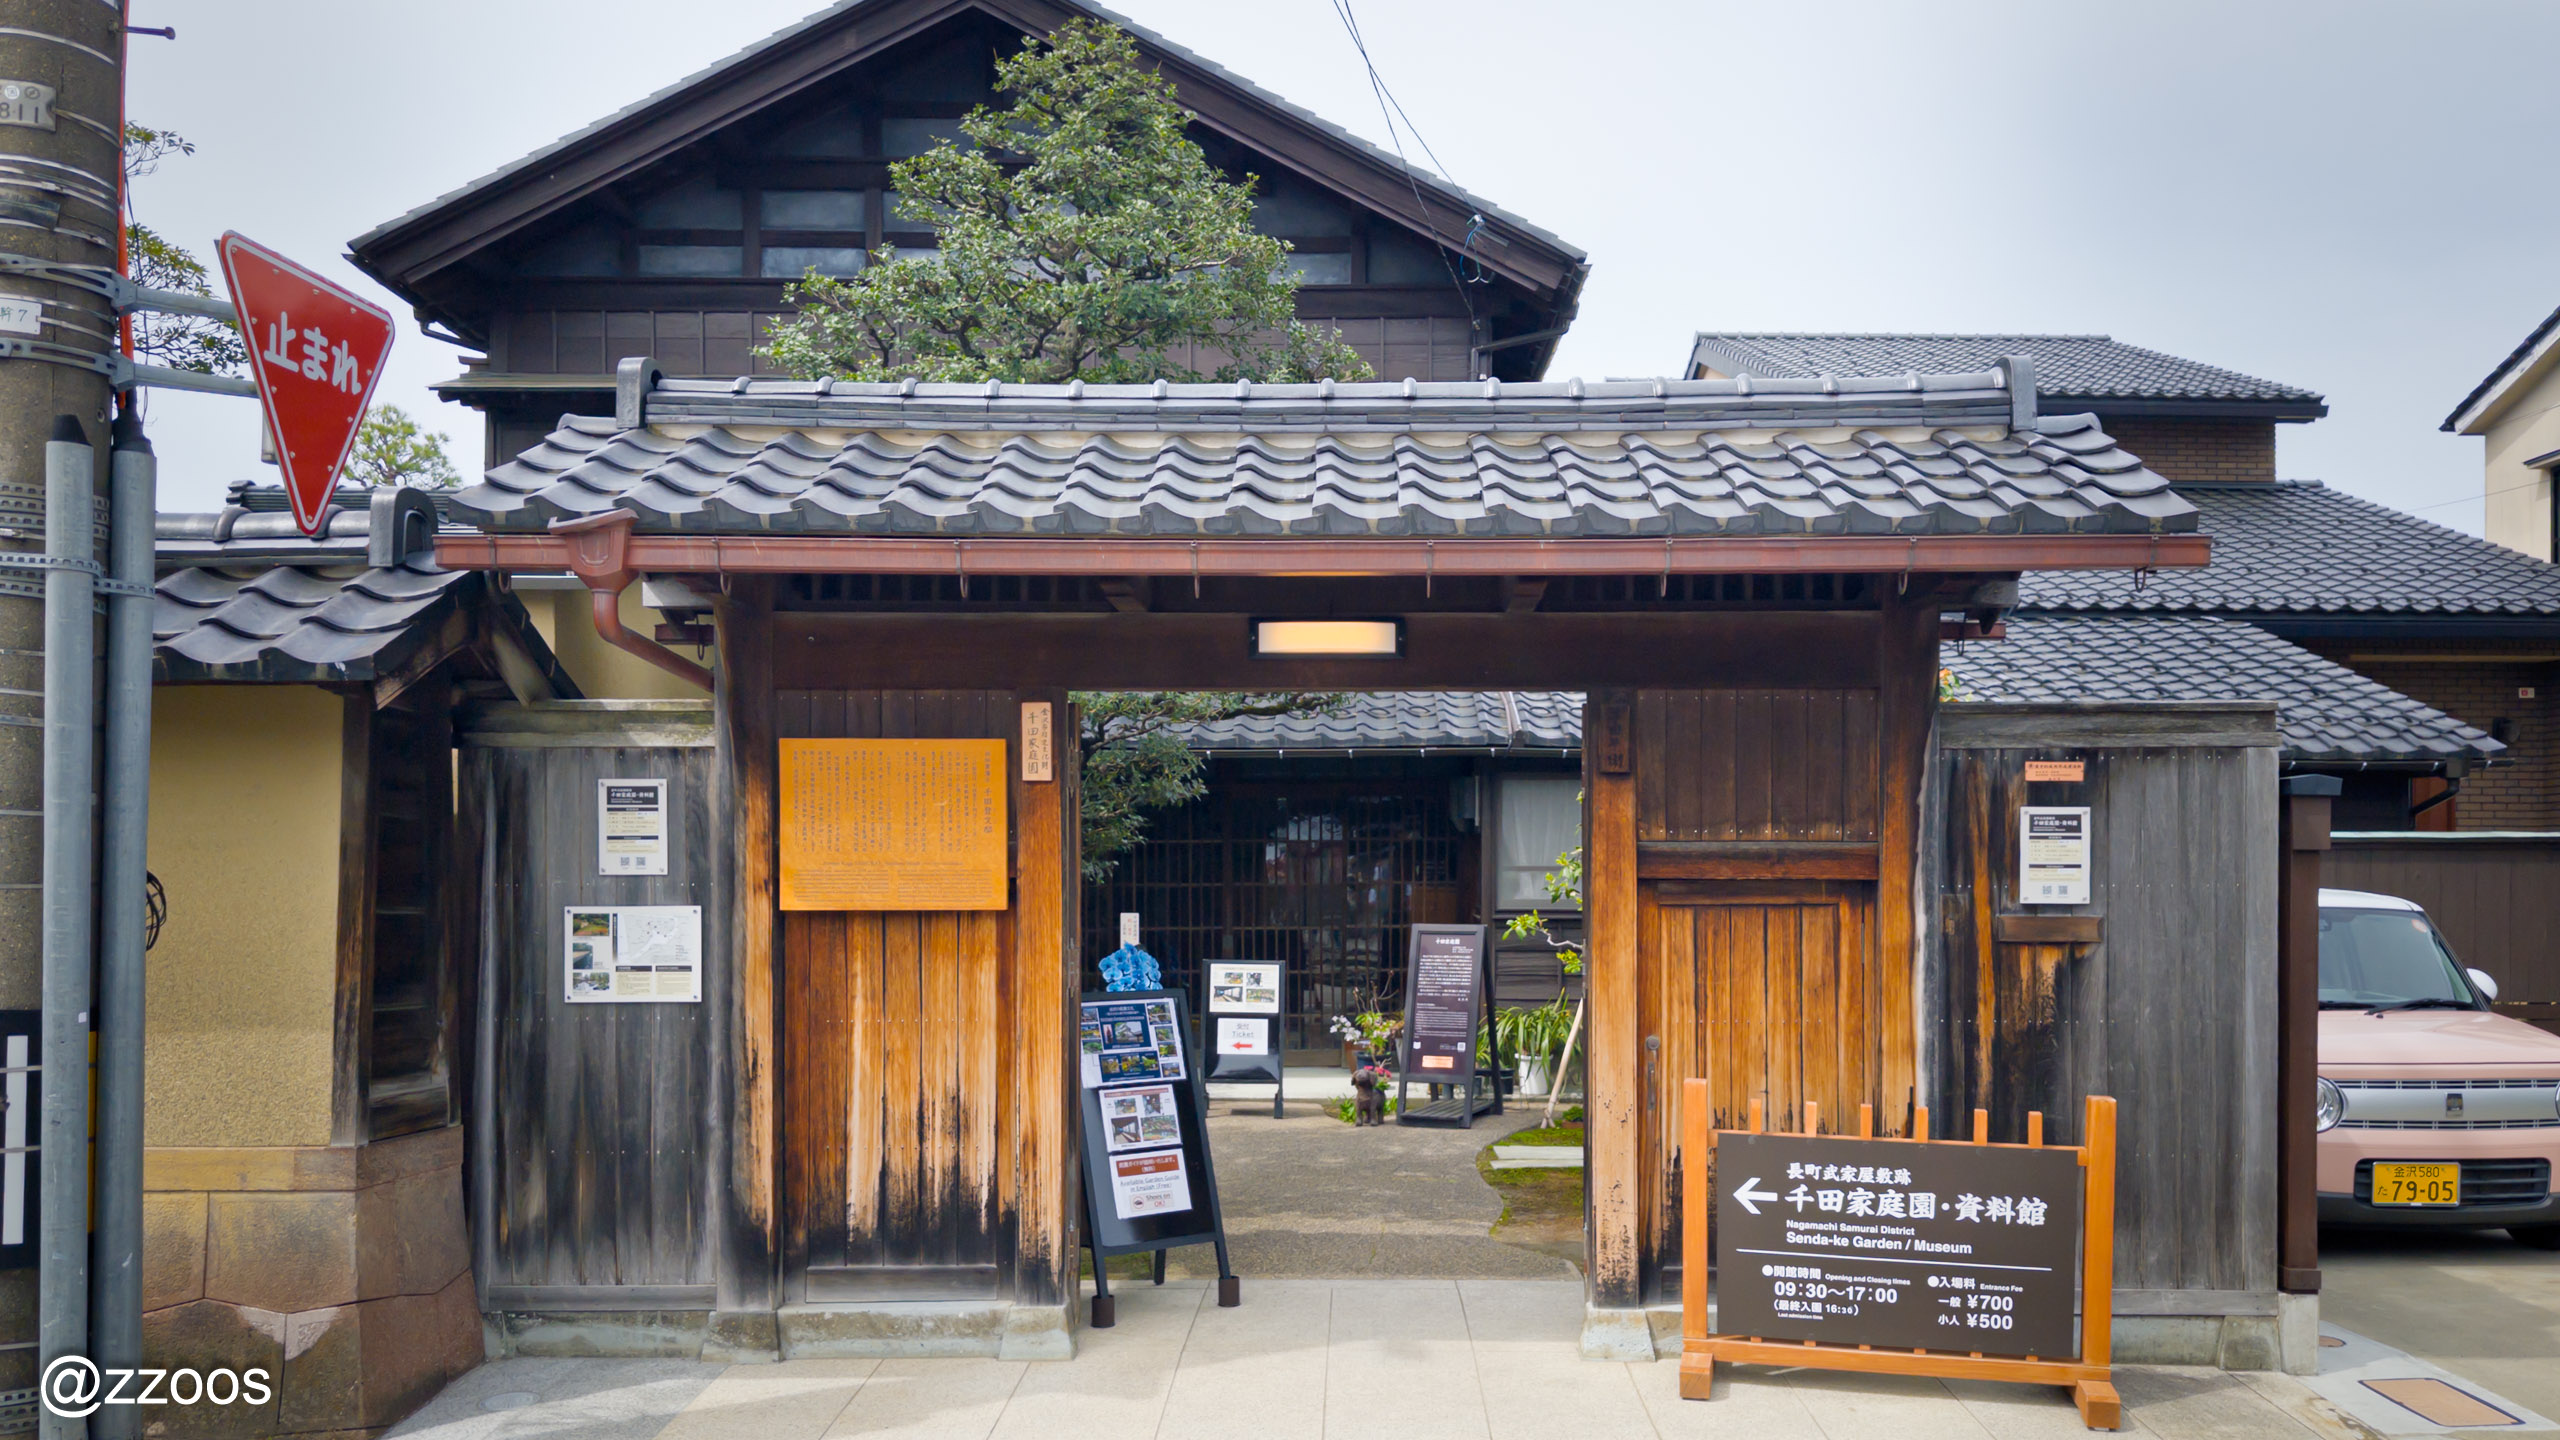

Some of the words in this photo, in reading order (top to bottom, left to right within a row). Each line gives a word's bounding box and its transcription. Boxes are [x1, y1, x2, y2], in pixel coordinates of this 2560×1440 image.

[263, 311, 362, 396] 止まれ
[1027, 711, 1040, 775] 千田家庭園
[1231, 1030, 1255, 1038] Ticket
[1786, 1162, 1912, 1186] 長町武家屋敷跡
[2377, 1185, 2388, 1196] た
[2391, 1180, 2454, 1202] 79-05
[1784, 1183, 2048, 1226] 千田家庭園・資料館
[1786, 1219, 1838, 1231] Nagamachi
[1839, 1222, 1879, 1234] Samurai
[1880, 1225, 1916, 1236] District
[1786, 1231, 1850, 1247] Senda-ke
[1852, 1236, 1903, 1250] Garden
[1914, 1239, 1973, 1254] Museum
[1824, 1273, 1853, 1283] Opening
[1853, 1274, 1866, 1283] and
[1866, 1276, 1892, 1286] Closing
[1892, 1277, 1911, 1286] times
[1938, 1276, 1975, 1290] 入場料
[1979, 1283, 2010, 1292] Entrance
[2010, 1285, 2024, 1293] Fee
[1938, 1296, 1962, 1308] 一般
[1967, 1294, 2014, 1312] ¥700
[1938, 1314, 1960, 1326] 小人
[1966, 1313, 2013, 1331] ¥500
